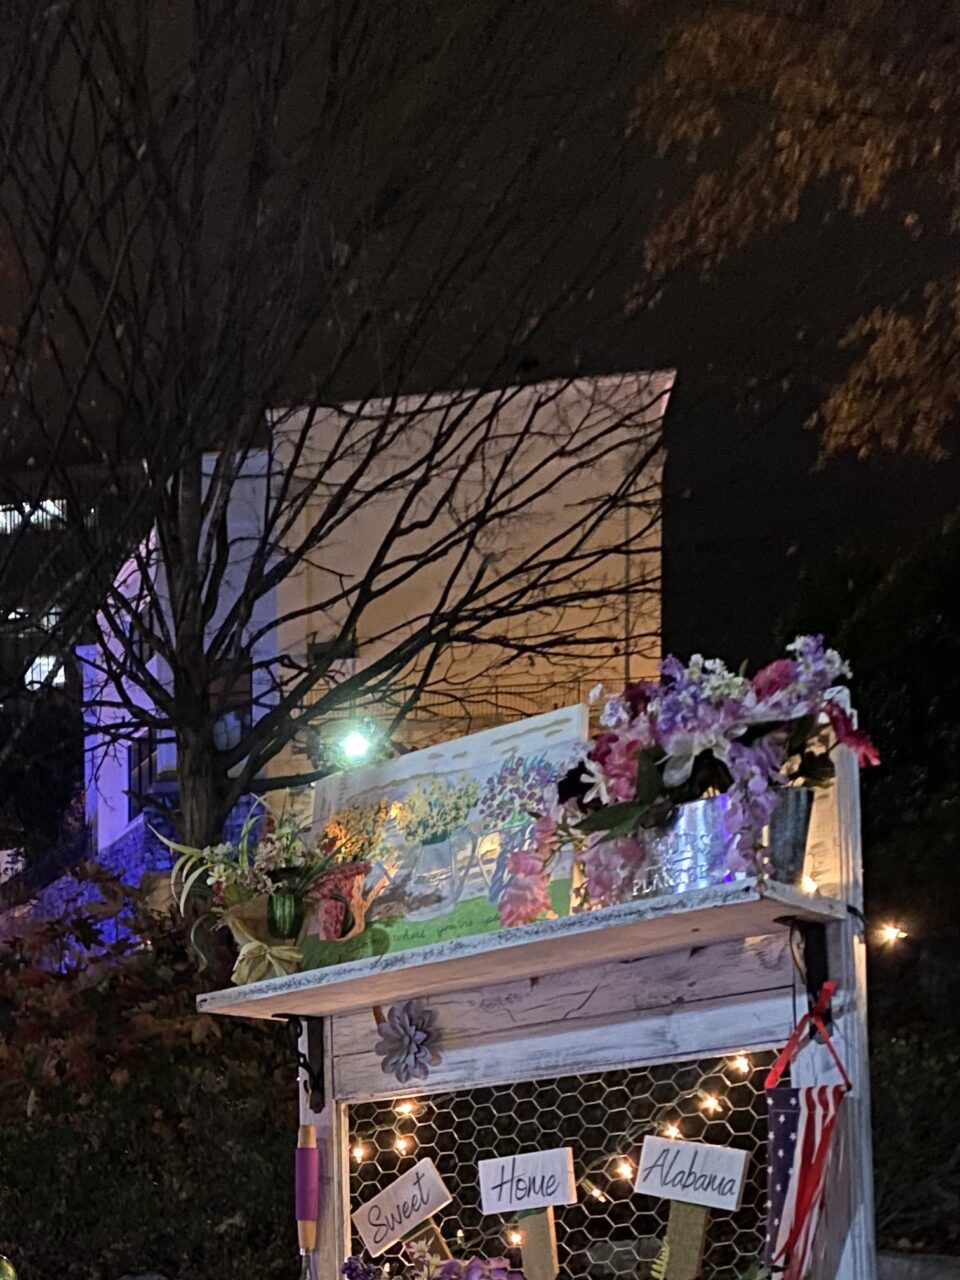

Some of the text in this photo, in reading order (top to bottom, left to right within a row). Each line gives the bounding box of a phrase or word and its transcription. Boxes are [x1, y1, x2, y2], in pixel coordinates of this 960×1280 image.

[490, 1159, 561, 1203] Home
[642, 1147, 738, 1197] Alabama
[366, 1171, 432, 1244] Sweet
